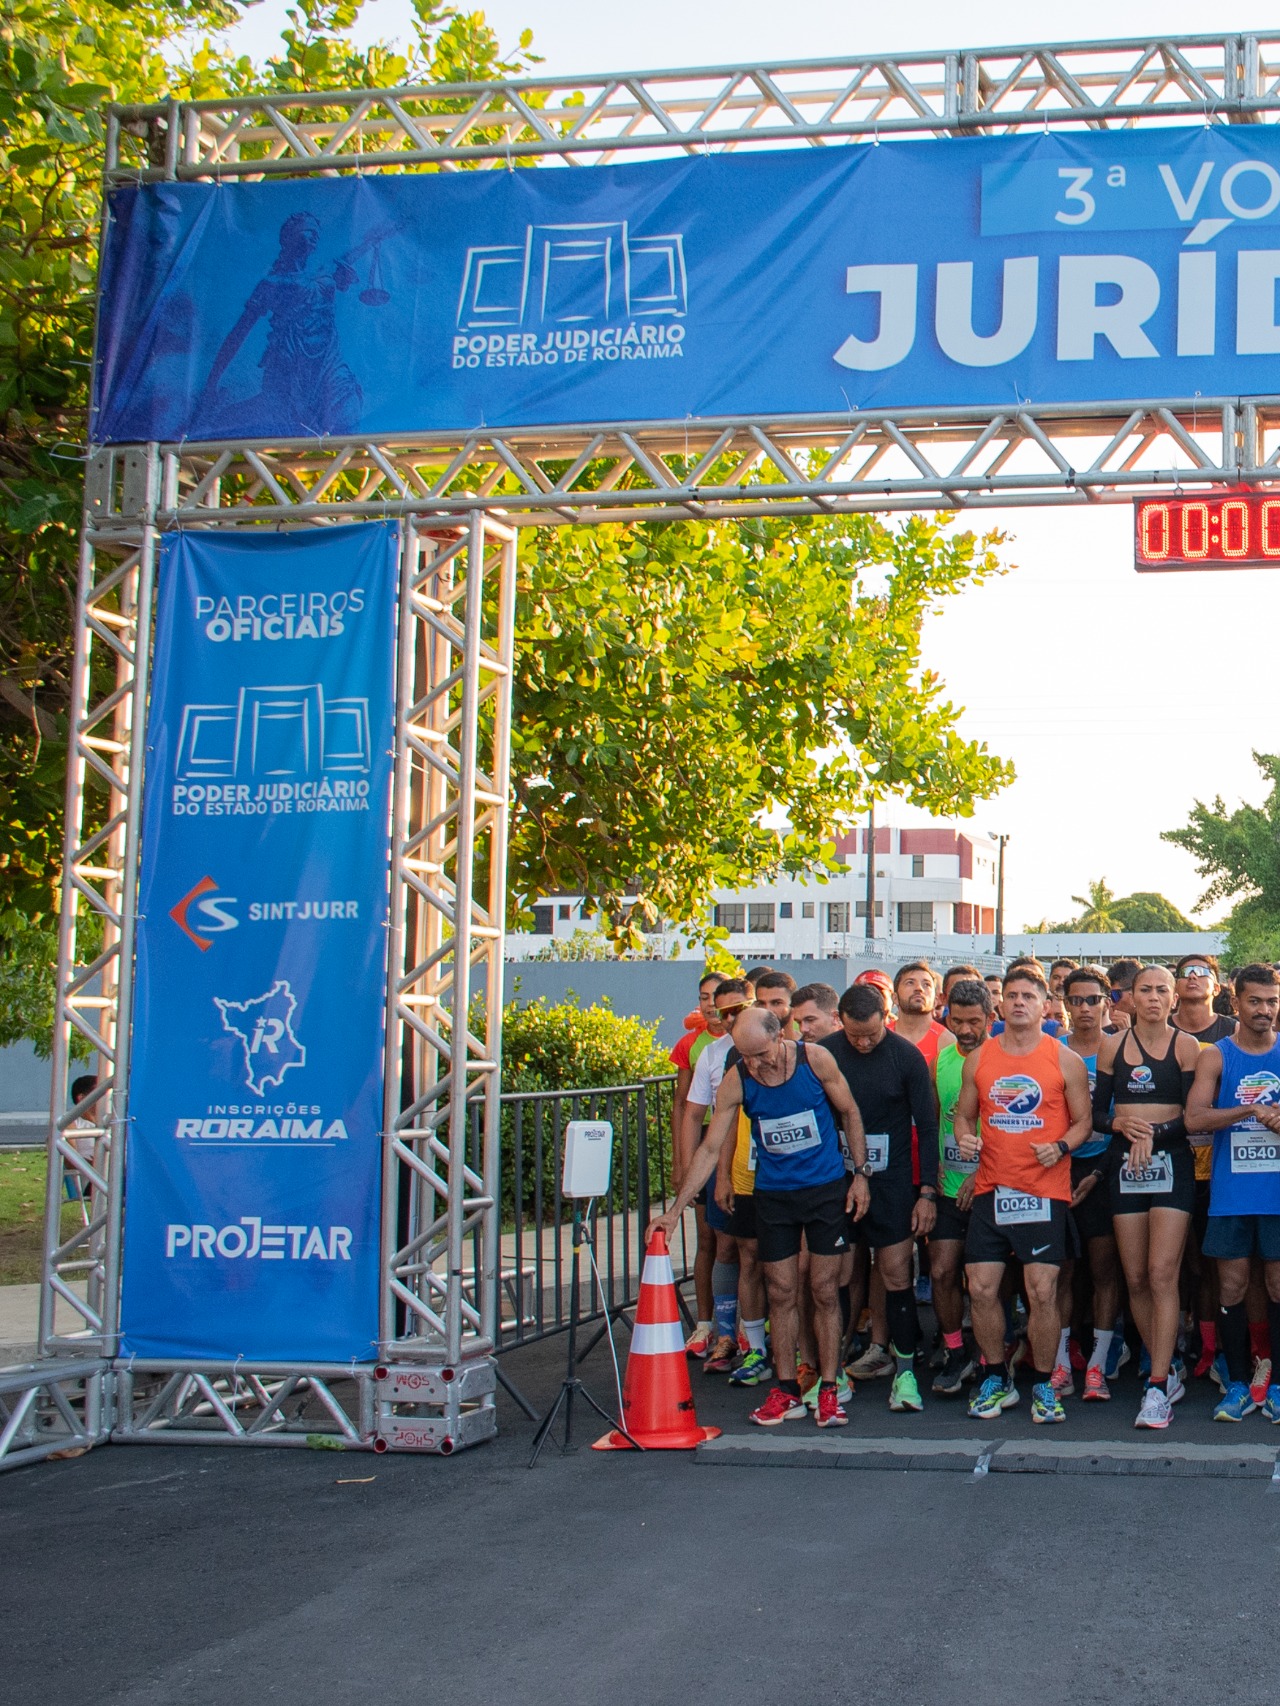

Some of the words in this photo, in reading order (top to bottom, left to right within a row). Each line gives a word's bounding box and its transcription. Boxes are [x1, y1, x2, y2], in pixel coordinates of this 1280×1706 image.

[1054, 163, 1127, 226] 3ª
[452, 332, 536, 354] PODER
[541, 322, 685, 351] JUDICIÁRIO
[452, 352, 482, 369] DO
[485, 348, 560, 367] ESTADO
[564, 346, 588, 363] DE
[592, 342, 684, 361] RORAIMA
[195, 589, 365, 619] PARCEIROS
[206, 612, 344, 642] OFICIAIS
[173, 785, 251, 802] PODER
[254, 776, 370, 802] JUDICIÁRIO
[173, 802, 200, 815] DO
[205, 801, 267, 815] ESTADO
[272, 800, 293, 814] DE
[297, 797, 370, 813] RORAIMA
[249, 901, 359, 921] SINTJURR
[208, 1101, 321, 1118] INSCRIÇÕES
[176, 1119, 348, 1139] RORAIMA
[771, 1128, 805, 1144] 0512
[1238, 1147, 1276, 1160] 0540
[1001, 1197, 1039, 1211] 0043
[166, 1216, 352, 1260] PROJETAR
